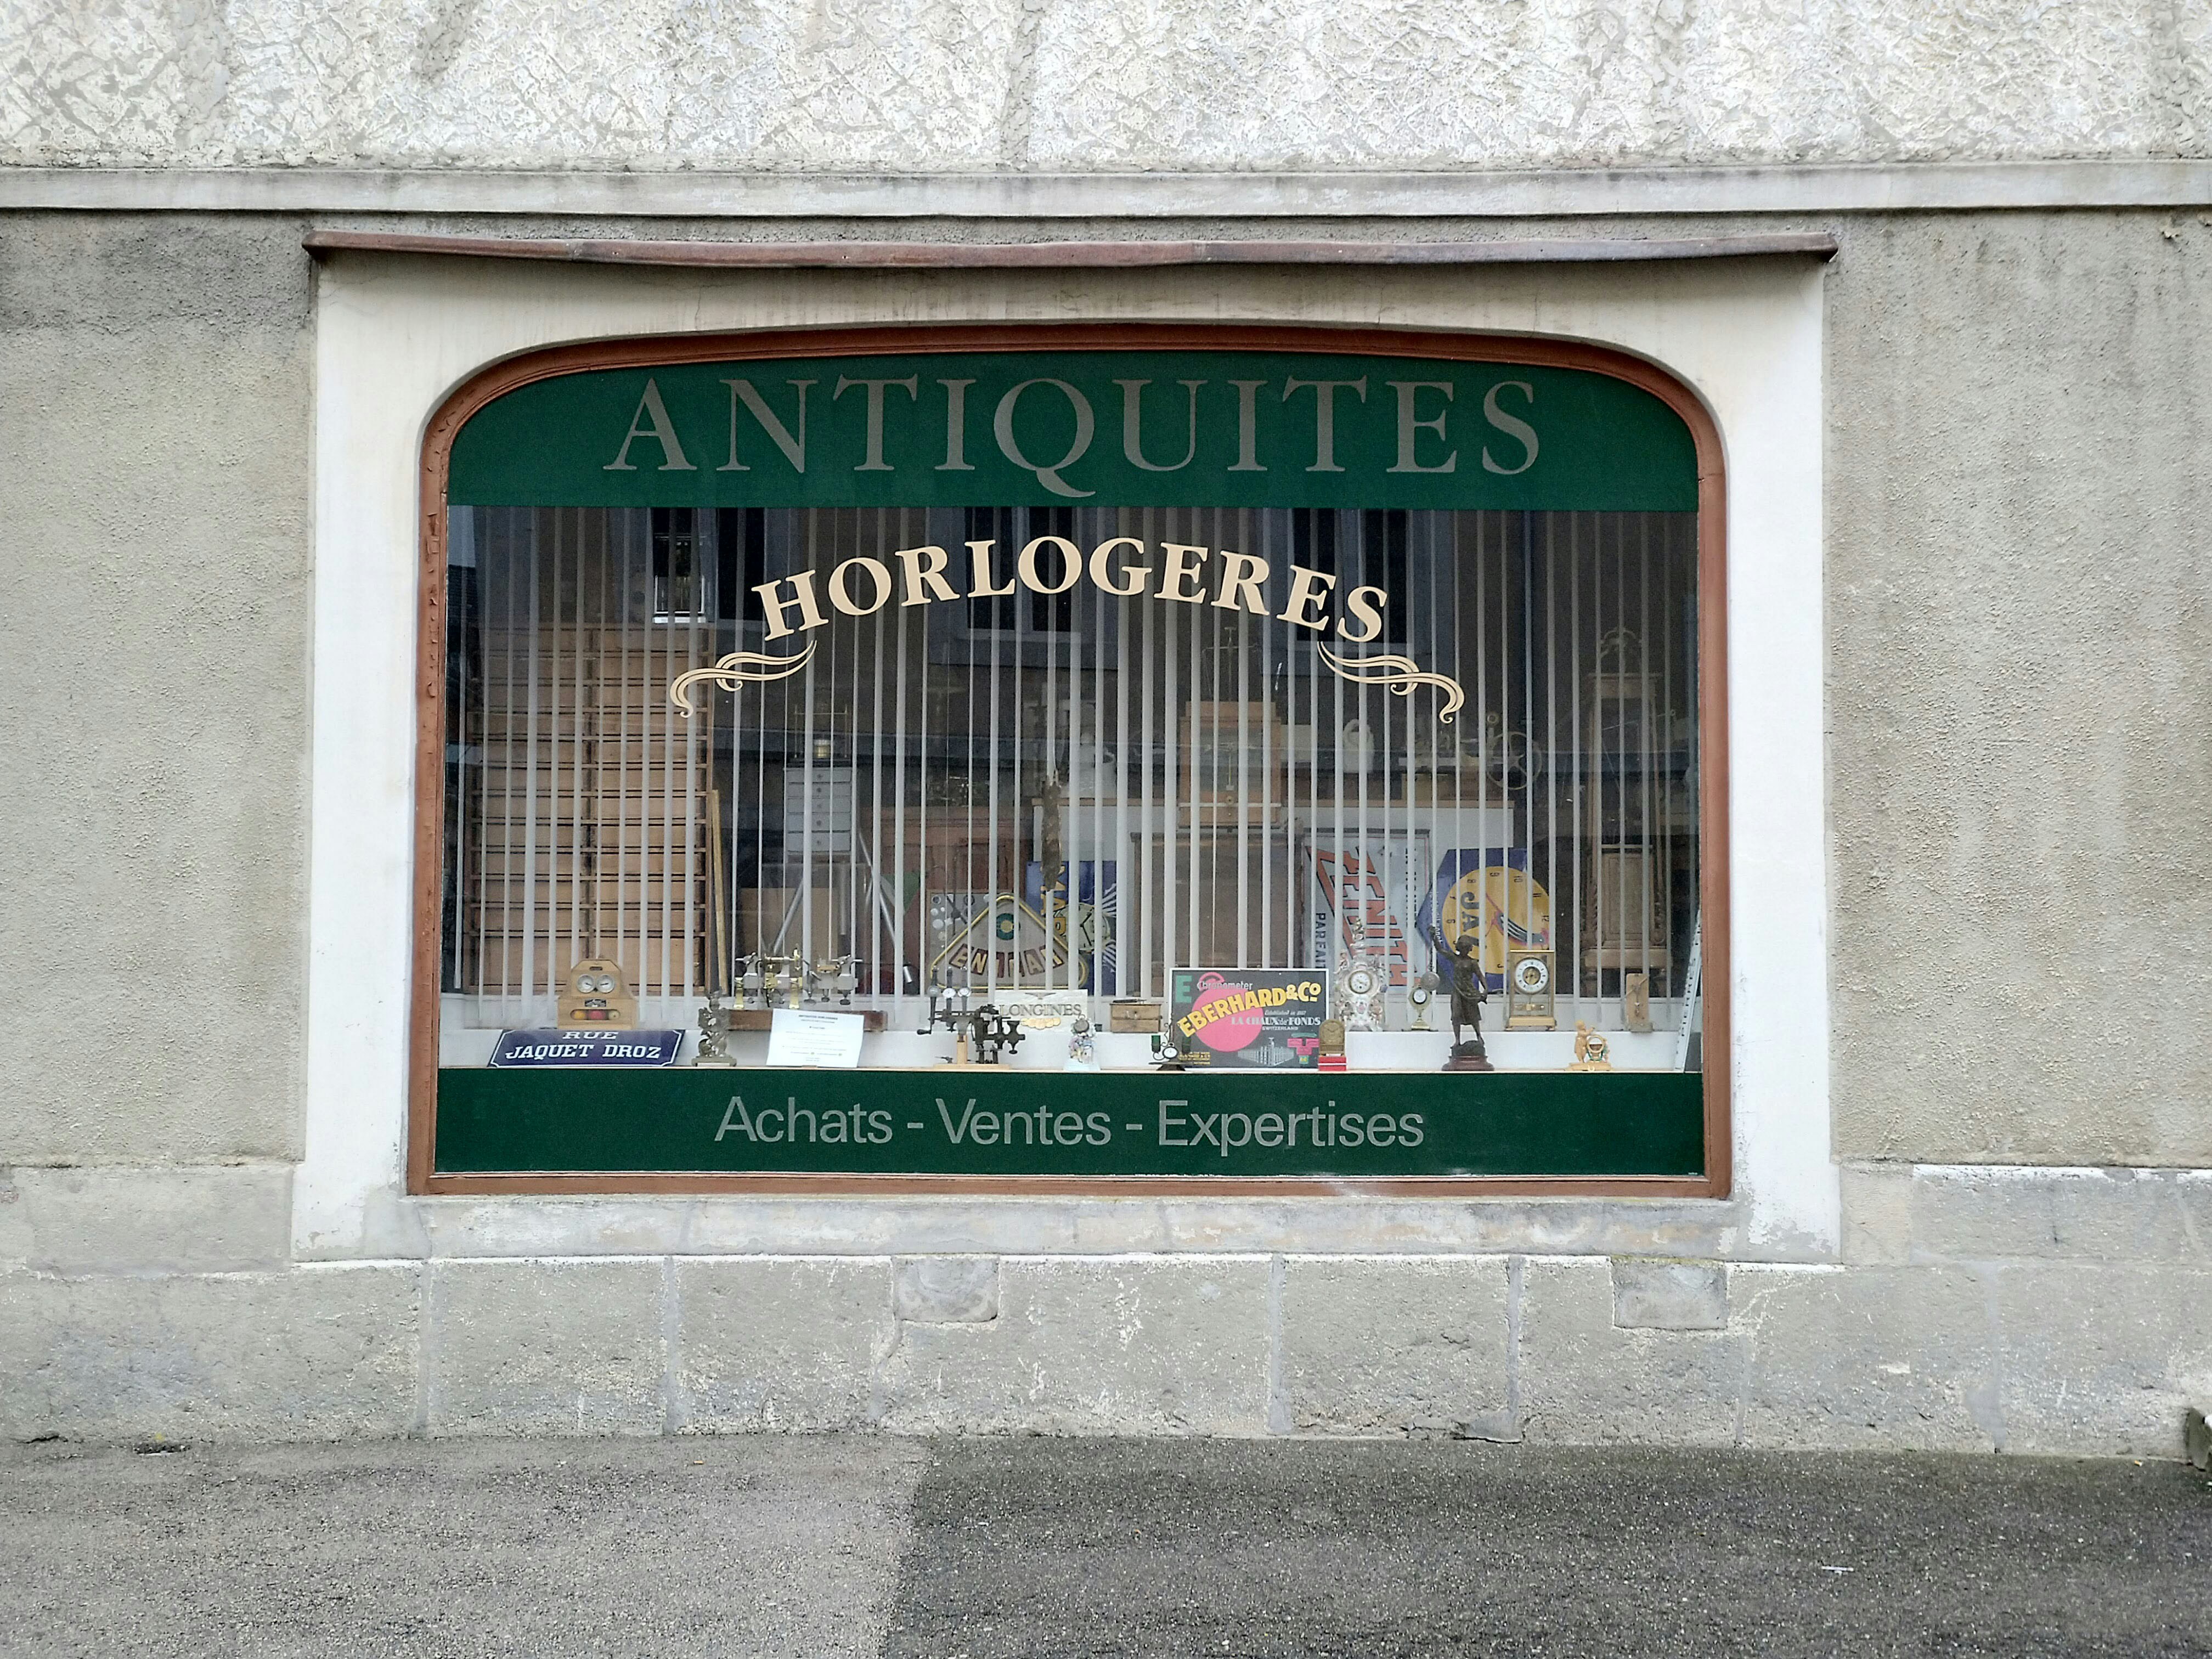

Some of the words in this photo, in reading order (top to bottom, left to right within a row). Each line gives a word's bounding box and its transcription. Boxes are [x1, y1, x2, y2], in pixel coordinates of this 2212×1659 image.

[604, 380, 1538, 497] ANTIQUITES
[752, 535, 1388, 642] HORLOGERES
[1196, 980, 1253, 991] Chronometer
[998, 1003, 1082, 1017] LONGINES
[562, 1031, 619, 1040] RUE
[505, 1045, 595, 1060] JAQUET
[602, 1045, 662, 1059] DROZ
[715, 1097, 892, 1143] Achats
[936, 1099, 1110, 1144] Ventes
[1159, 1101, 1423, 1156] Expertises
